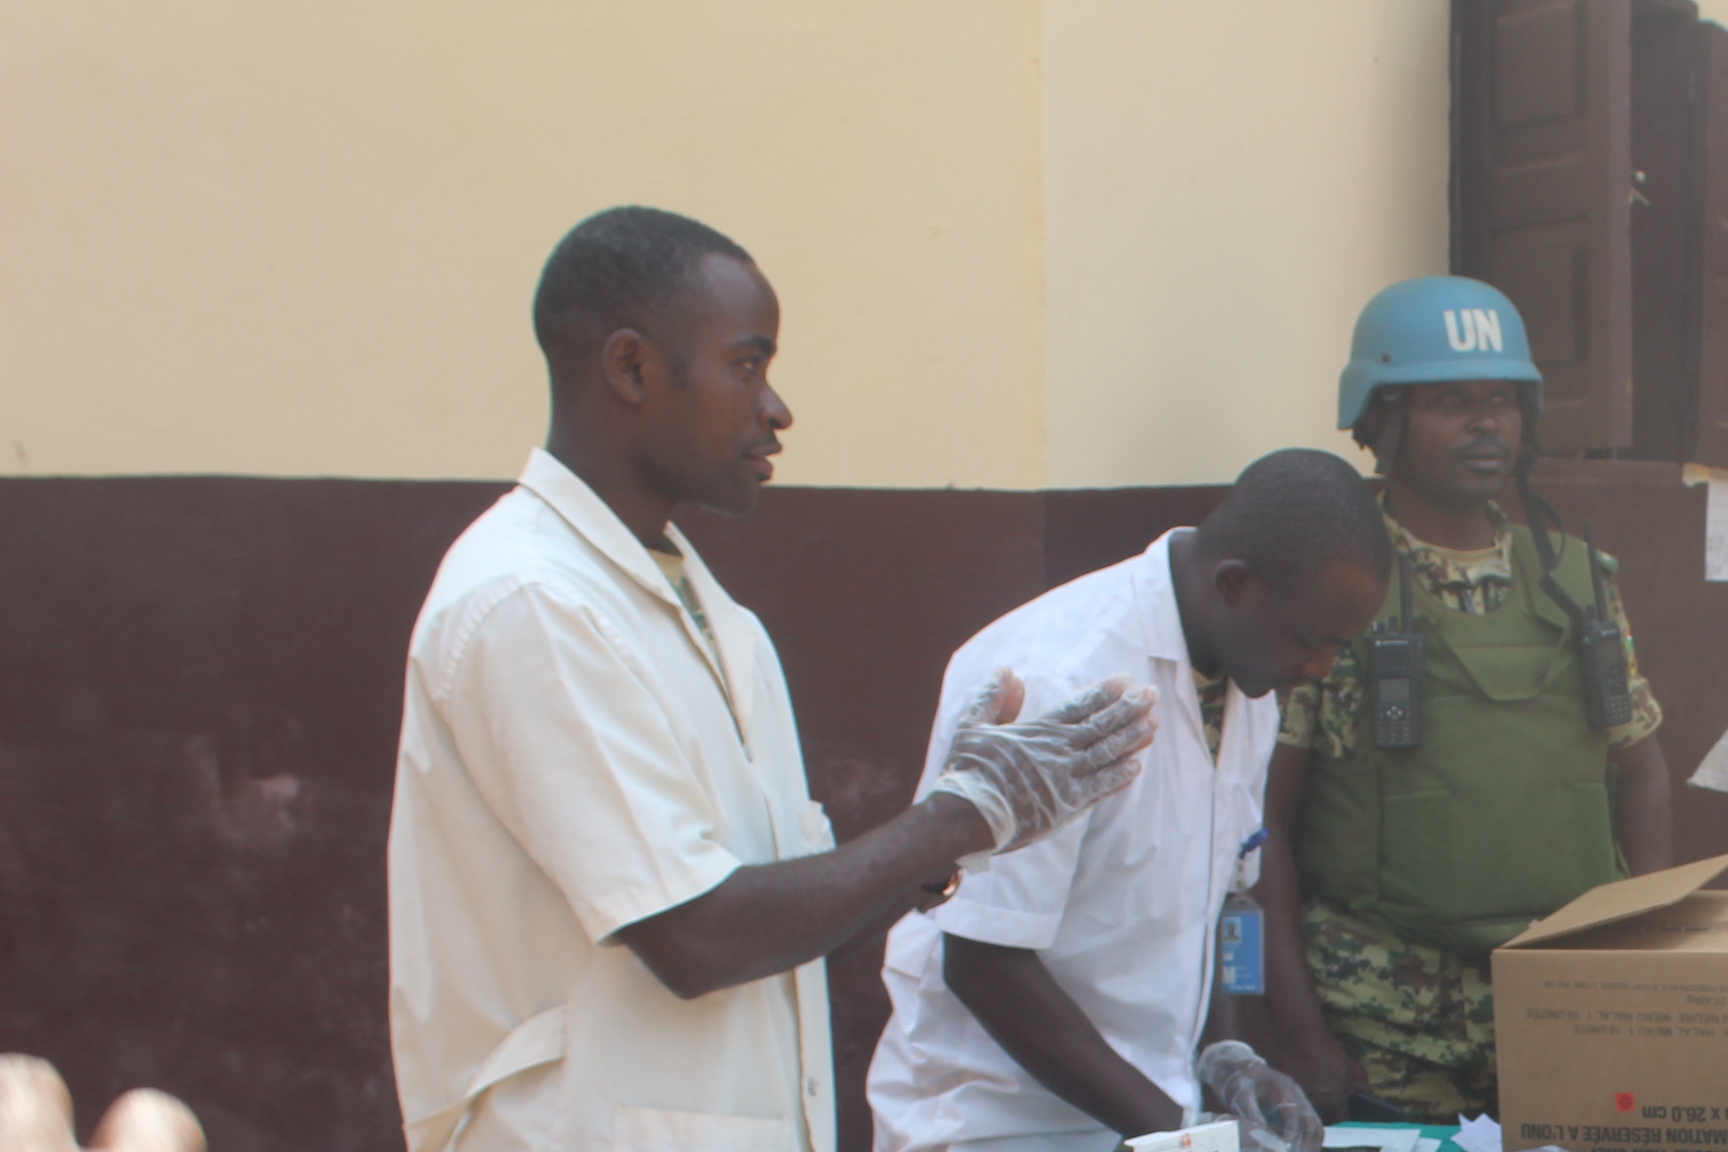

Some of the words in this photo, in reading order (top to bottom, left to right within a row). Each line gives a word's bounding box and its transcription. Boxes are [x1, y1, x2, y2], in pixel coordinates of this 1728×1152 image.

[1443, 308, 1503, 351] UN
[1642, 1106, 1667, 1119] cm
[1671, 1107, 1706, 1123] 26.0
[1711, 1108, 1720, 1120] x
[1521, 1123, 1564, 1140] L'ONU
[1568, 1125, 1579, 1141] A
[1583, 1126, 1662, 1146] RÉSERVÉE
